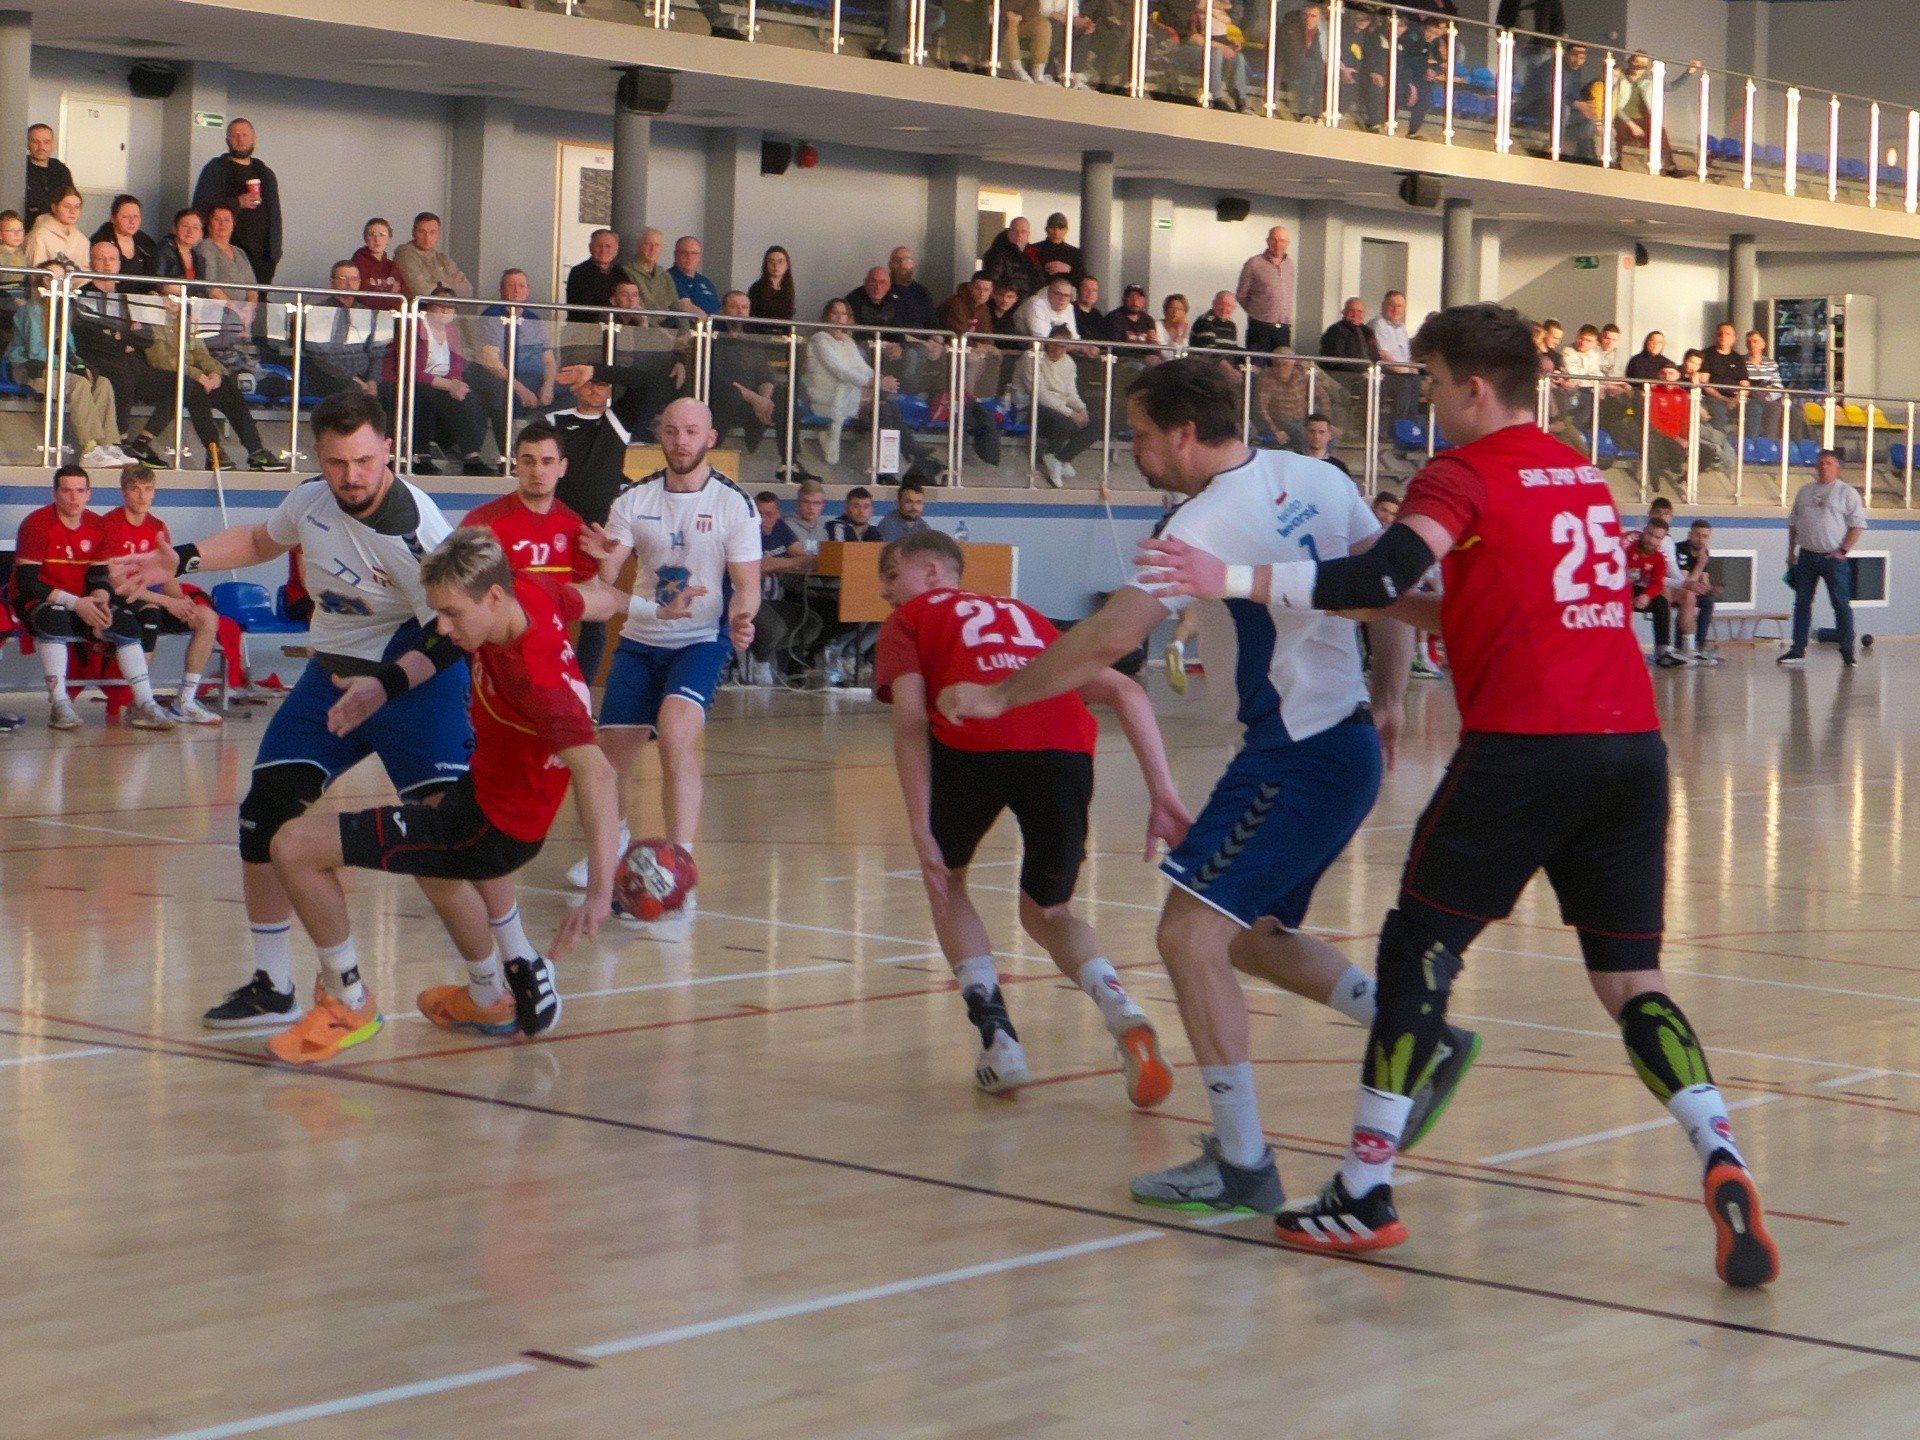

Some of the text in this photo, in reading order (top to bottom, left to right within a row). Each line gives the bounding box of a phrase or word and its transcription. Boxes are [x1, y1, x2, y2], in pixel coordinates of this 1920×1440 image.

[530, 544, 550, 565] 17
[669, 530, 685, 550] 14
[1551, 504, 1627, 602] 25
[955, 599, 1046, 649] 21
